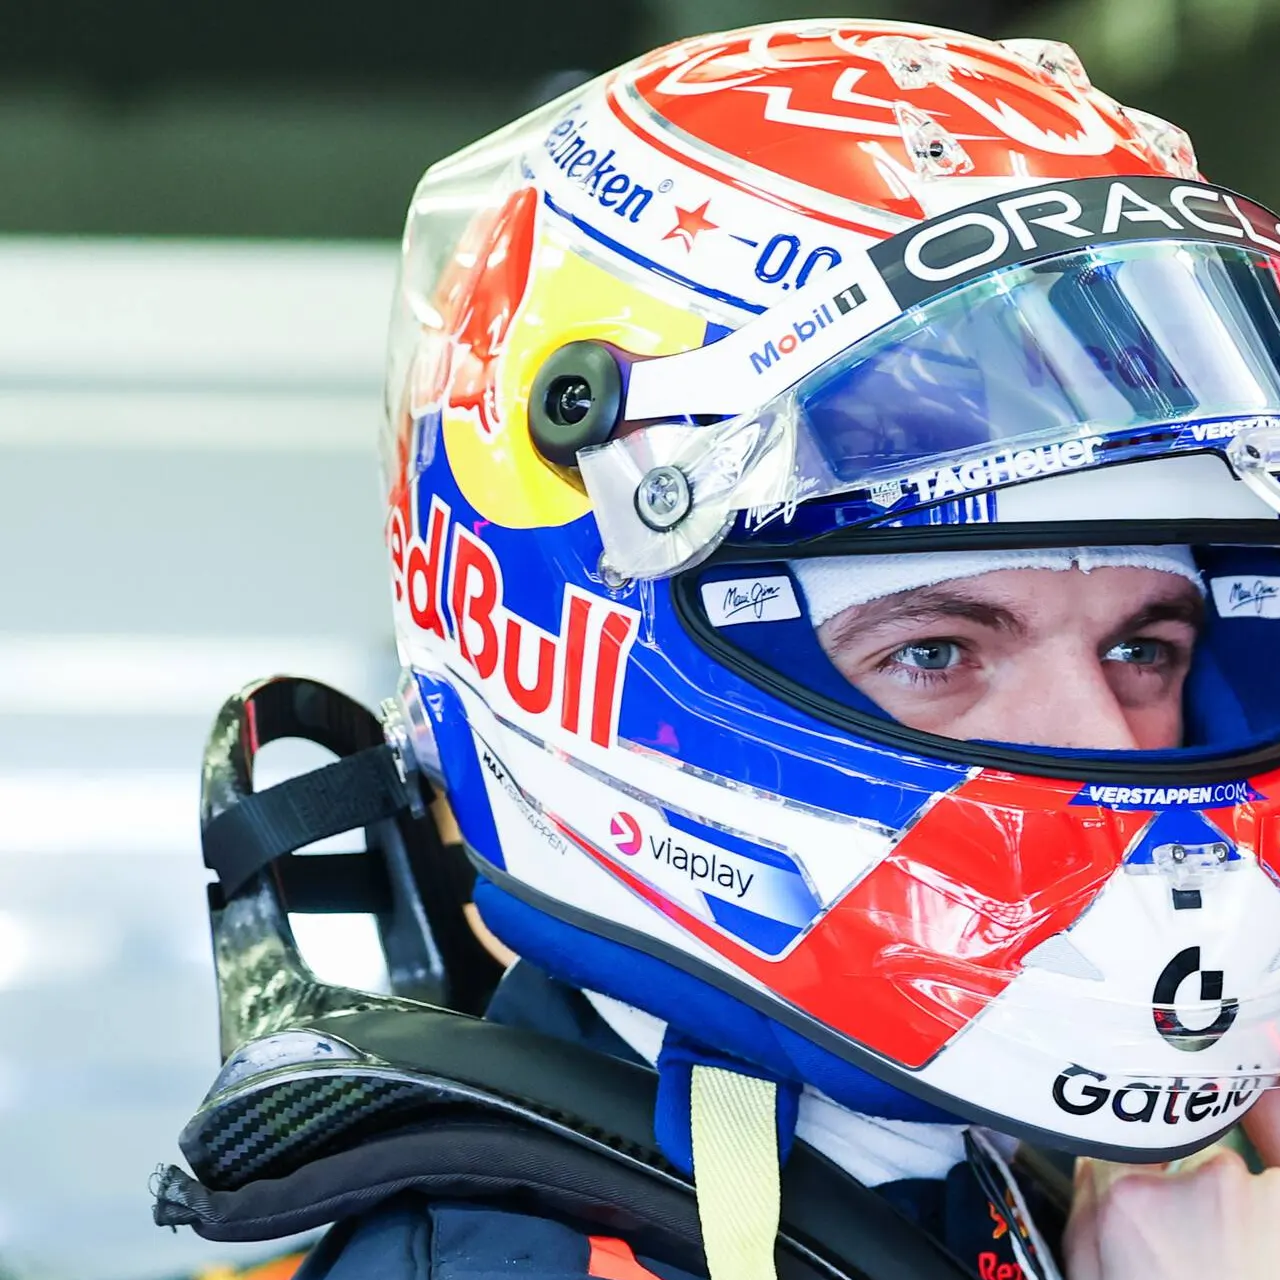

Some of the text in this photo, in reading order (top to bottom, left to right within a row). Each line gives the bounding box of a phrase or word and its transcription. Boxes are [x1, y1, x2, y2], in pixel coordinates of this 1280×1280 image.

[543, 113, 653, 223] eineken
[749, 287, 862, 375] Mobil 1
[386, 508, 633, 749] ed Bull
[482, 751, 505, 785] MAX
[1089, 782, 1249, 805] VERSTAPPEN.COM
[649, 833, 755, 899] viaplay
